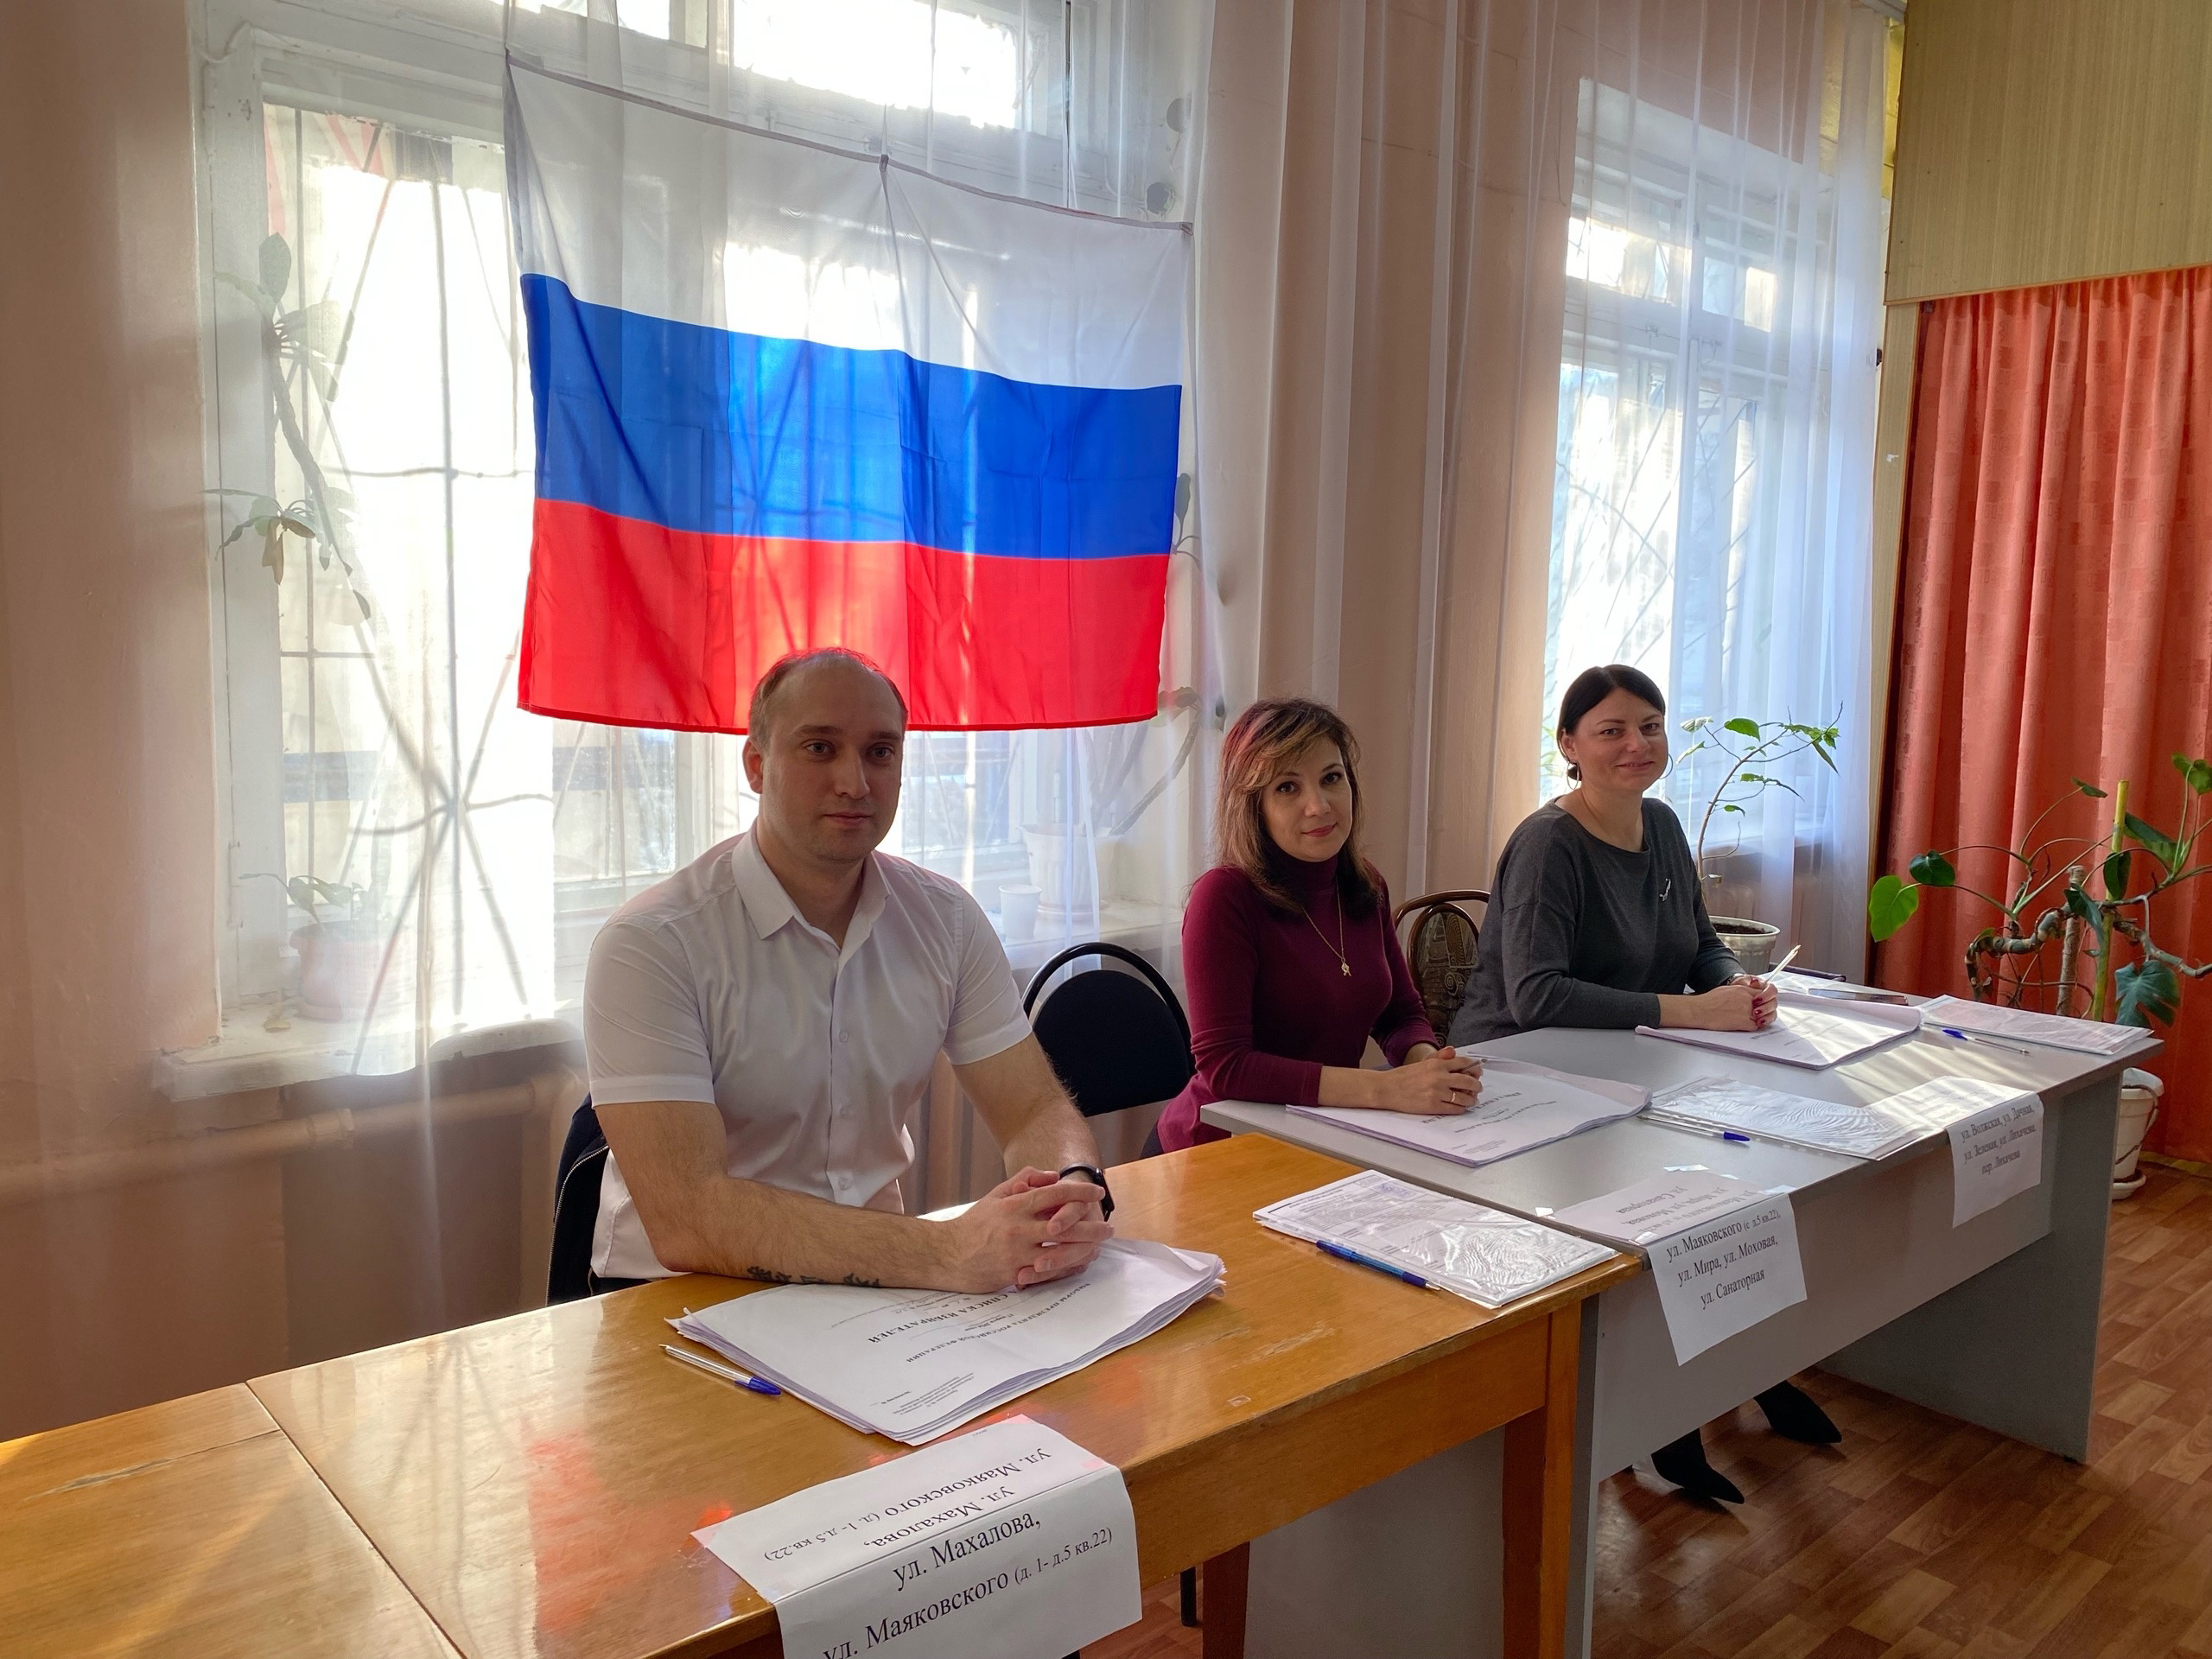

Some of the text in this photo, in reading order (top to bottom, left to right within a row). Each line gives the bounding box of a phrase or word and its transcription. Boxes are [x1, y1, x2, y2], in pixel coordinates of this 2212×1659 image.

[1667, 1246, 1681, 1263] ул.
[1681, 1223, 1742, 1253] Маяковского
[1678, 1236, 1778, 1287] ул. Мира, ул. Моховая,
[1700, 1269, 1765, 1310] ул. Санаторная
[868, 1312, 959, 1344] ИЗБИРАТЕЛЕЙ
[1019, 1448, 1052, 1464] ул.
[885, 1463, 1023, 1516] Маяковского
[863, 1486, 1015, 1547] ул. Махалова,
[764, 1539, 812, 1561] кв.22)
[893, 1513, 1041, 1592] ул. Махалова,
[865, 1573, 1008, 1649] Маяковского
[1014, 1567, 1032, 1585] (д.
[1037, 1558, 1049, 1572] 1-
[1052, 1545, 1071, 1567] д.5
[1075, 1527, 1112, 1555] кв.22)
